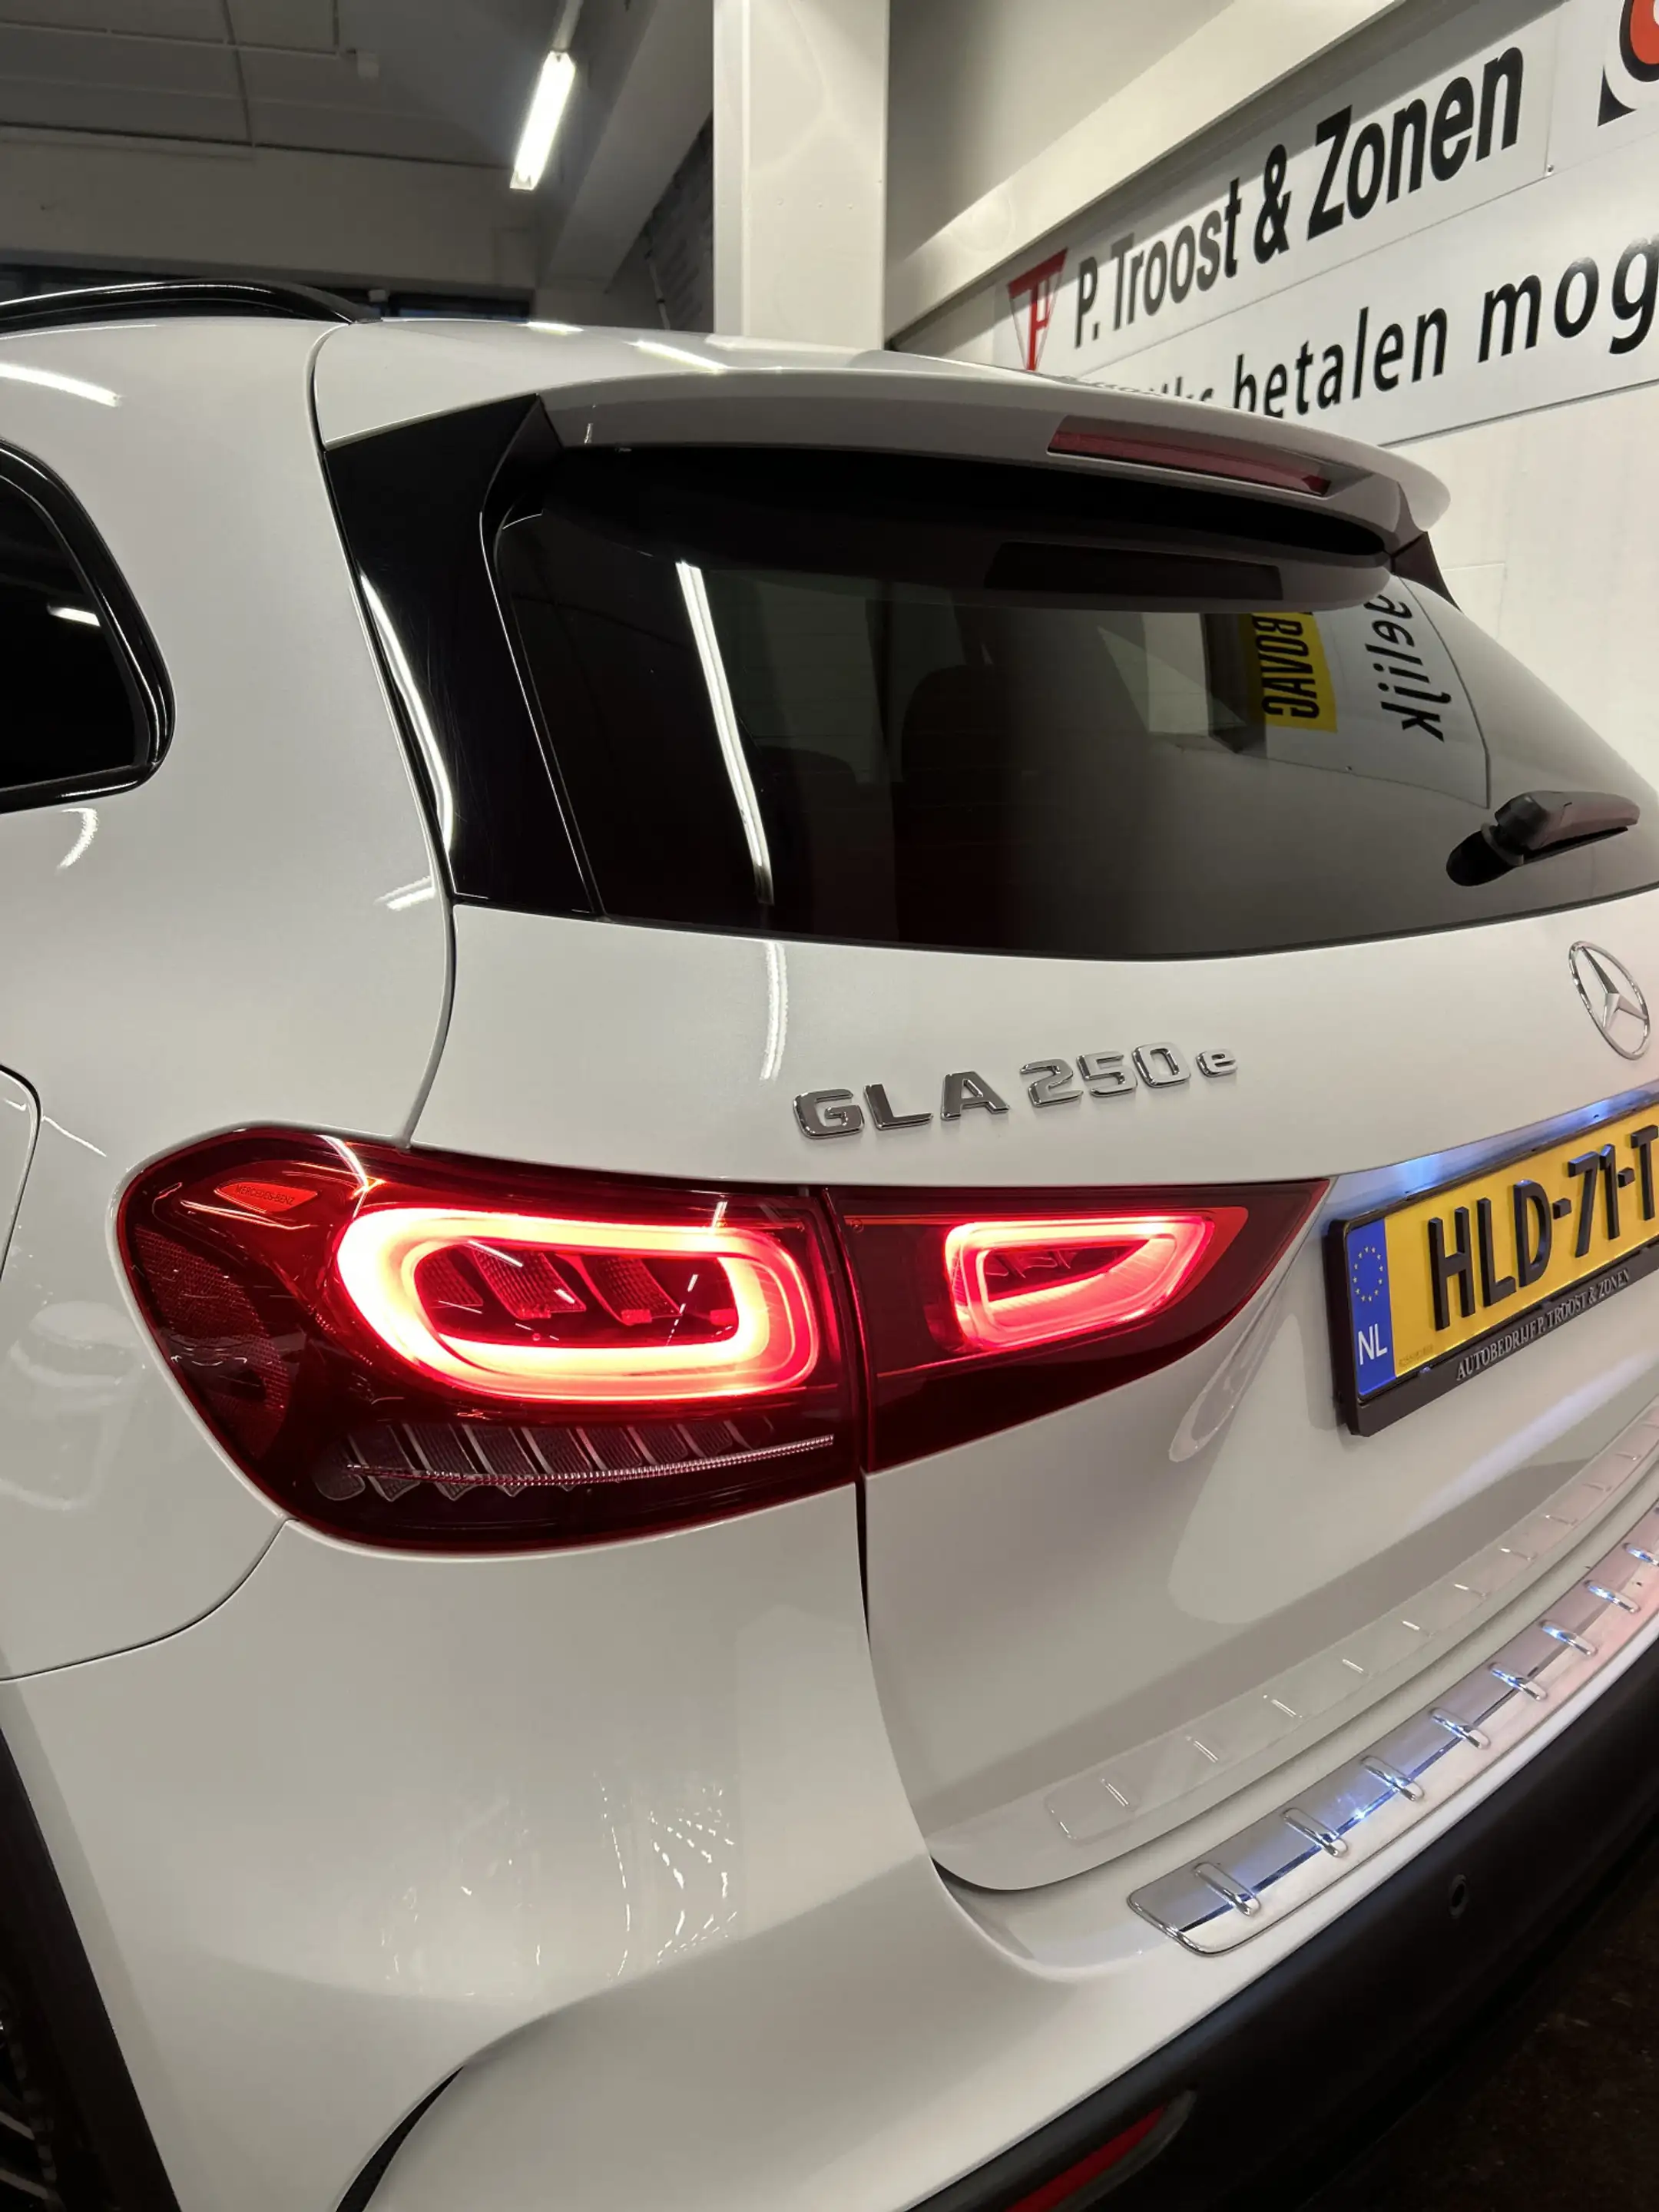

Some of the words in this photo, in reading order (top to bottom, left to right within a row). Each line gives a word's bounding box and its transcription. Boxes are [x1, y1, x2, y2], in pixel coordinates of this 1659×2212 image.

[1075, 256, 1099, 348] P.
[1111, 177, 1241, 330] Troost
[1253, 144, 1292, 263] &
[1308, 47, 1524, 240] Zonen
[1233, 307, 1447, 416] betalen
[793, 1069, 1009, 1139] GLA
[1020, 1042, 1191, 1108] 250
[1197, 1047, 1237, 1077] e
[1357, 1323, 1387, 1365] NL
[1456, 1322, 1536, 1381] AUTOBEDRIJF
[1546, 1291, 1587, 1329] TROOST
[1587, 1287, 1598, 1305] &
[1598, 1269, 1630, 1300] ZONEN
